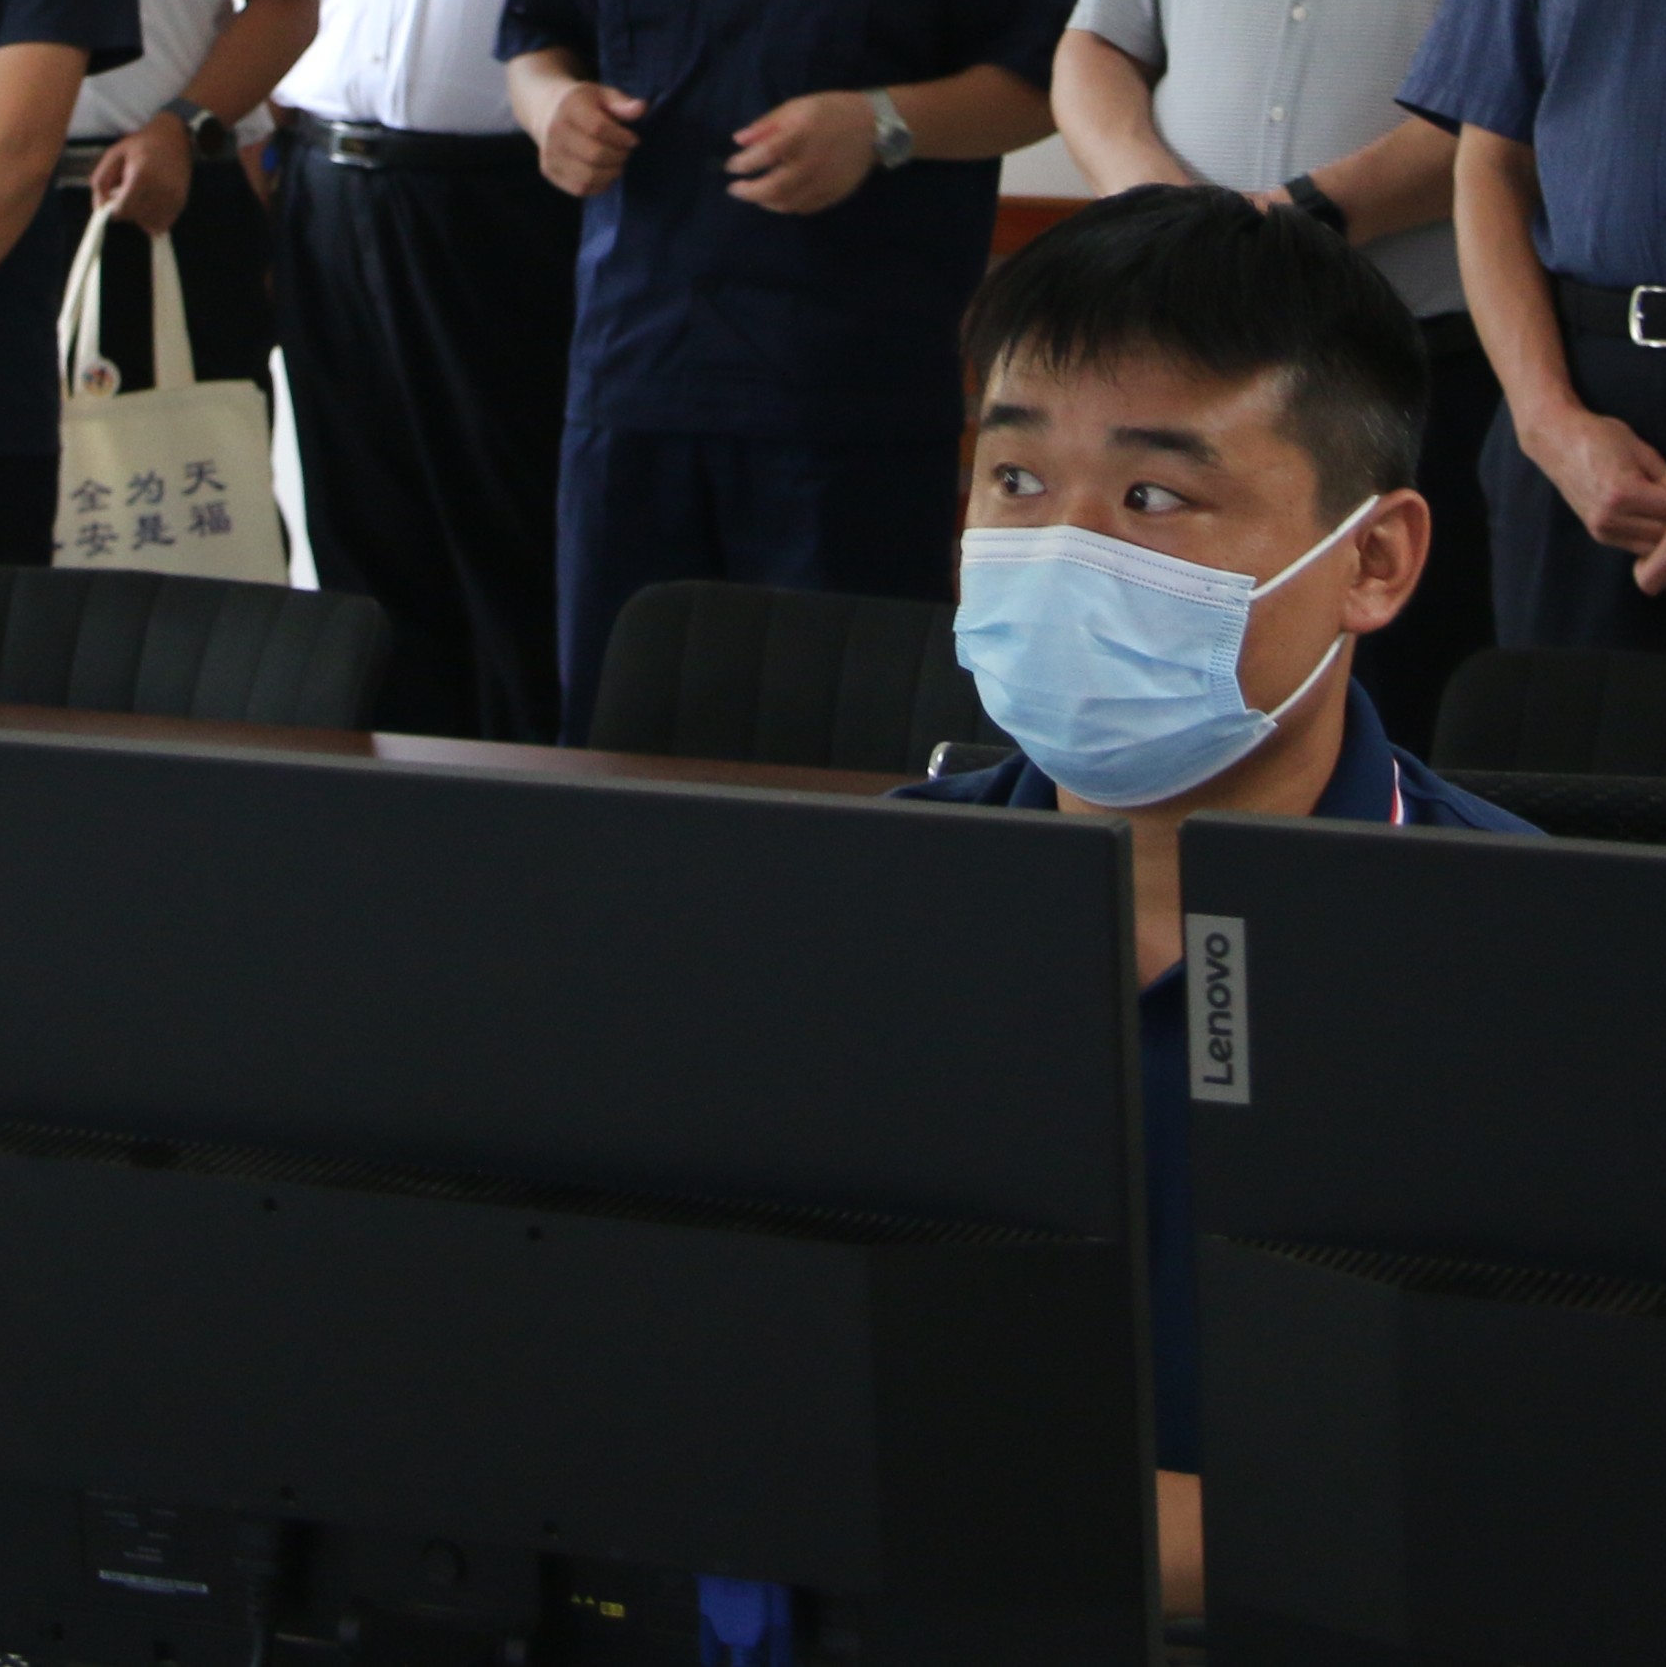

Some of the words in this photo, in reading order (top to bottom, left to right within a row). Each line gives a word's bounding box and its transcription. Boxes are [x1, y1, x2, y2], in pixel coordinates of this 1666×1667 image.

[72, 459, 227, 515] 全为天
[53, 501, 232, 557] 安是福
[1203, 931, 1235, 1087] Lenovo
